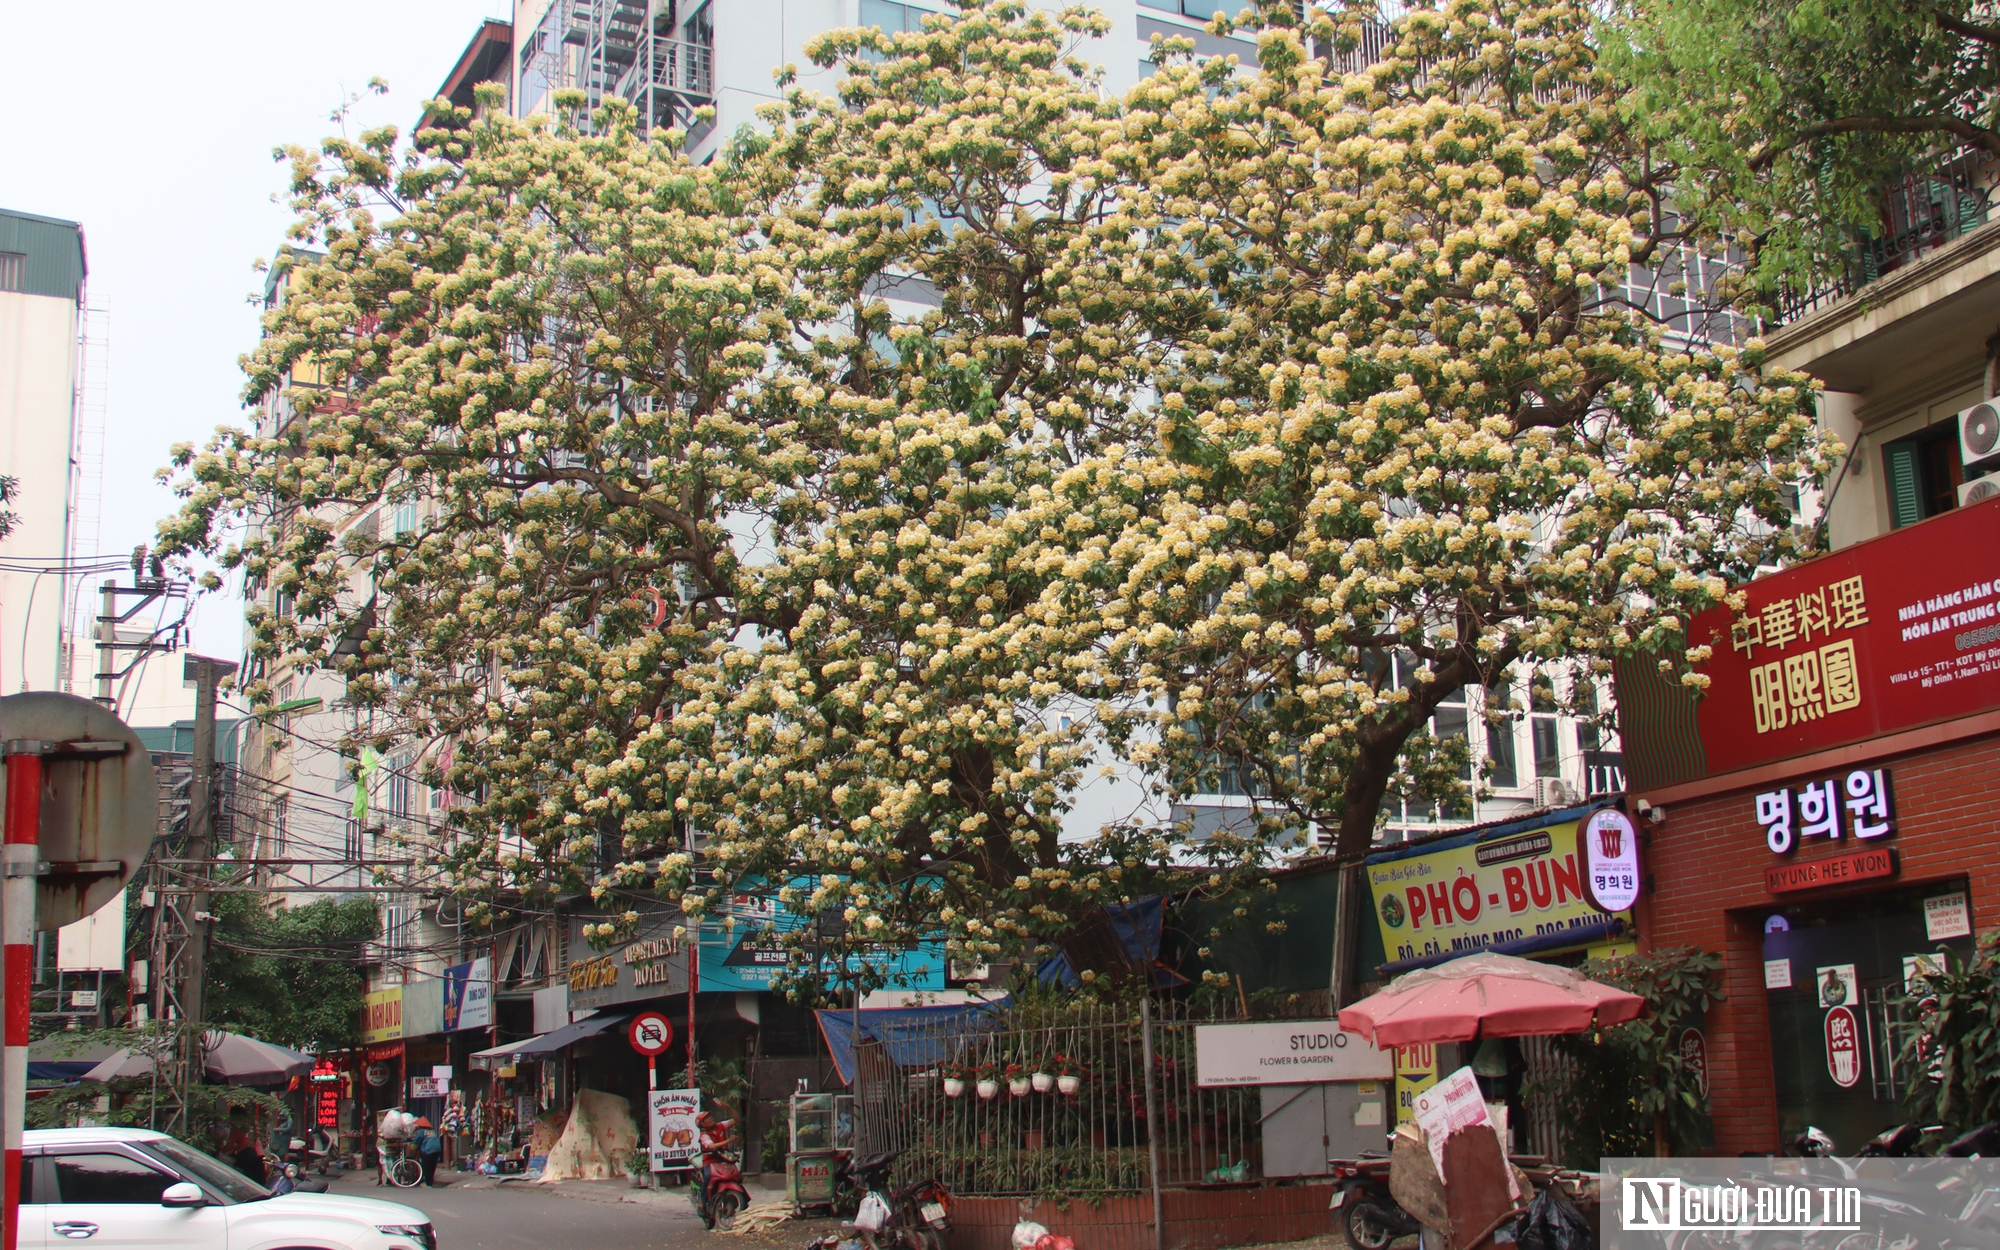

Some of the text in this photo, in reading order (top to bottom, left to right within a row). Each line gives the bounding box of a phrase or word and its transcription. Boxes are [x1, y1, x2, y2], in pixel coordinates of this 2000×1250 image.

[1731, 575, 1869, 659] 中華料理
[1898, 600, 1925, 621] NHÀ
[1926, 594, 1962, 613] HÀNG
[1963, 583, 1992, 602] HÀN
[1902, 622, 1930, 641] MÓN
[1932, 617, 1950, 633] ĂN
[1951, 602, 1995, 627] TRUNG
[1755, 768, 1890, 854] 명희원
[1595, 875, 1633, 890] 명희원
[1769, 854, 1887, 888] MYUNG HEE WON
[1405, 866, 1481, 930] PHỞ
[1502, 853, 1582, 913] BÚN
[1290, 1033, 1348, 1050] STUDIO
[1260, 1057, 1291, 1065] FLOWER
[1300, 1055, 1333, 1064] GARDEN
[801, 1165, 830, 1177] MÍA
